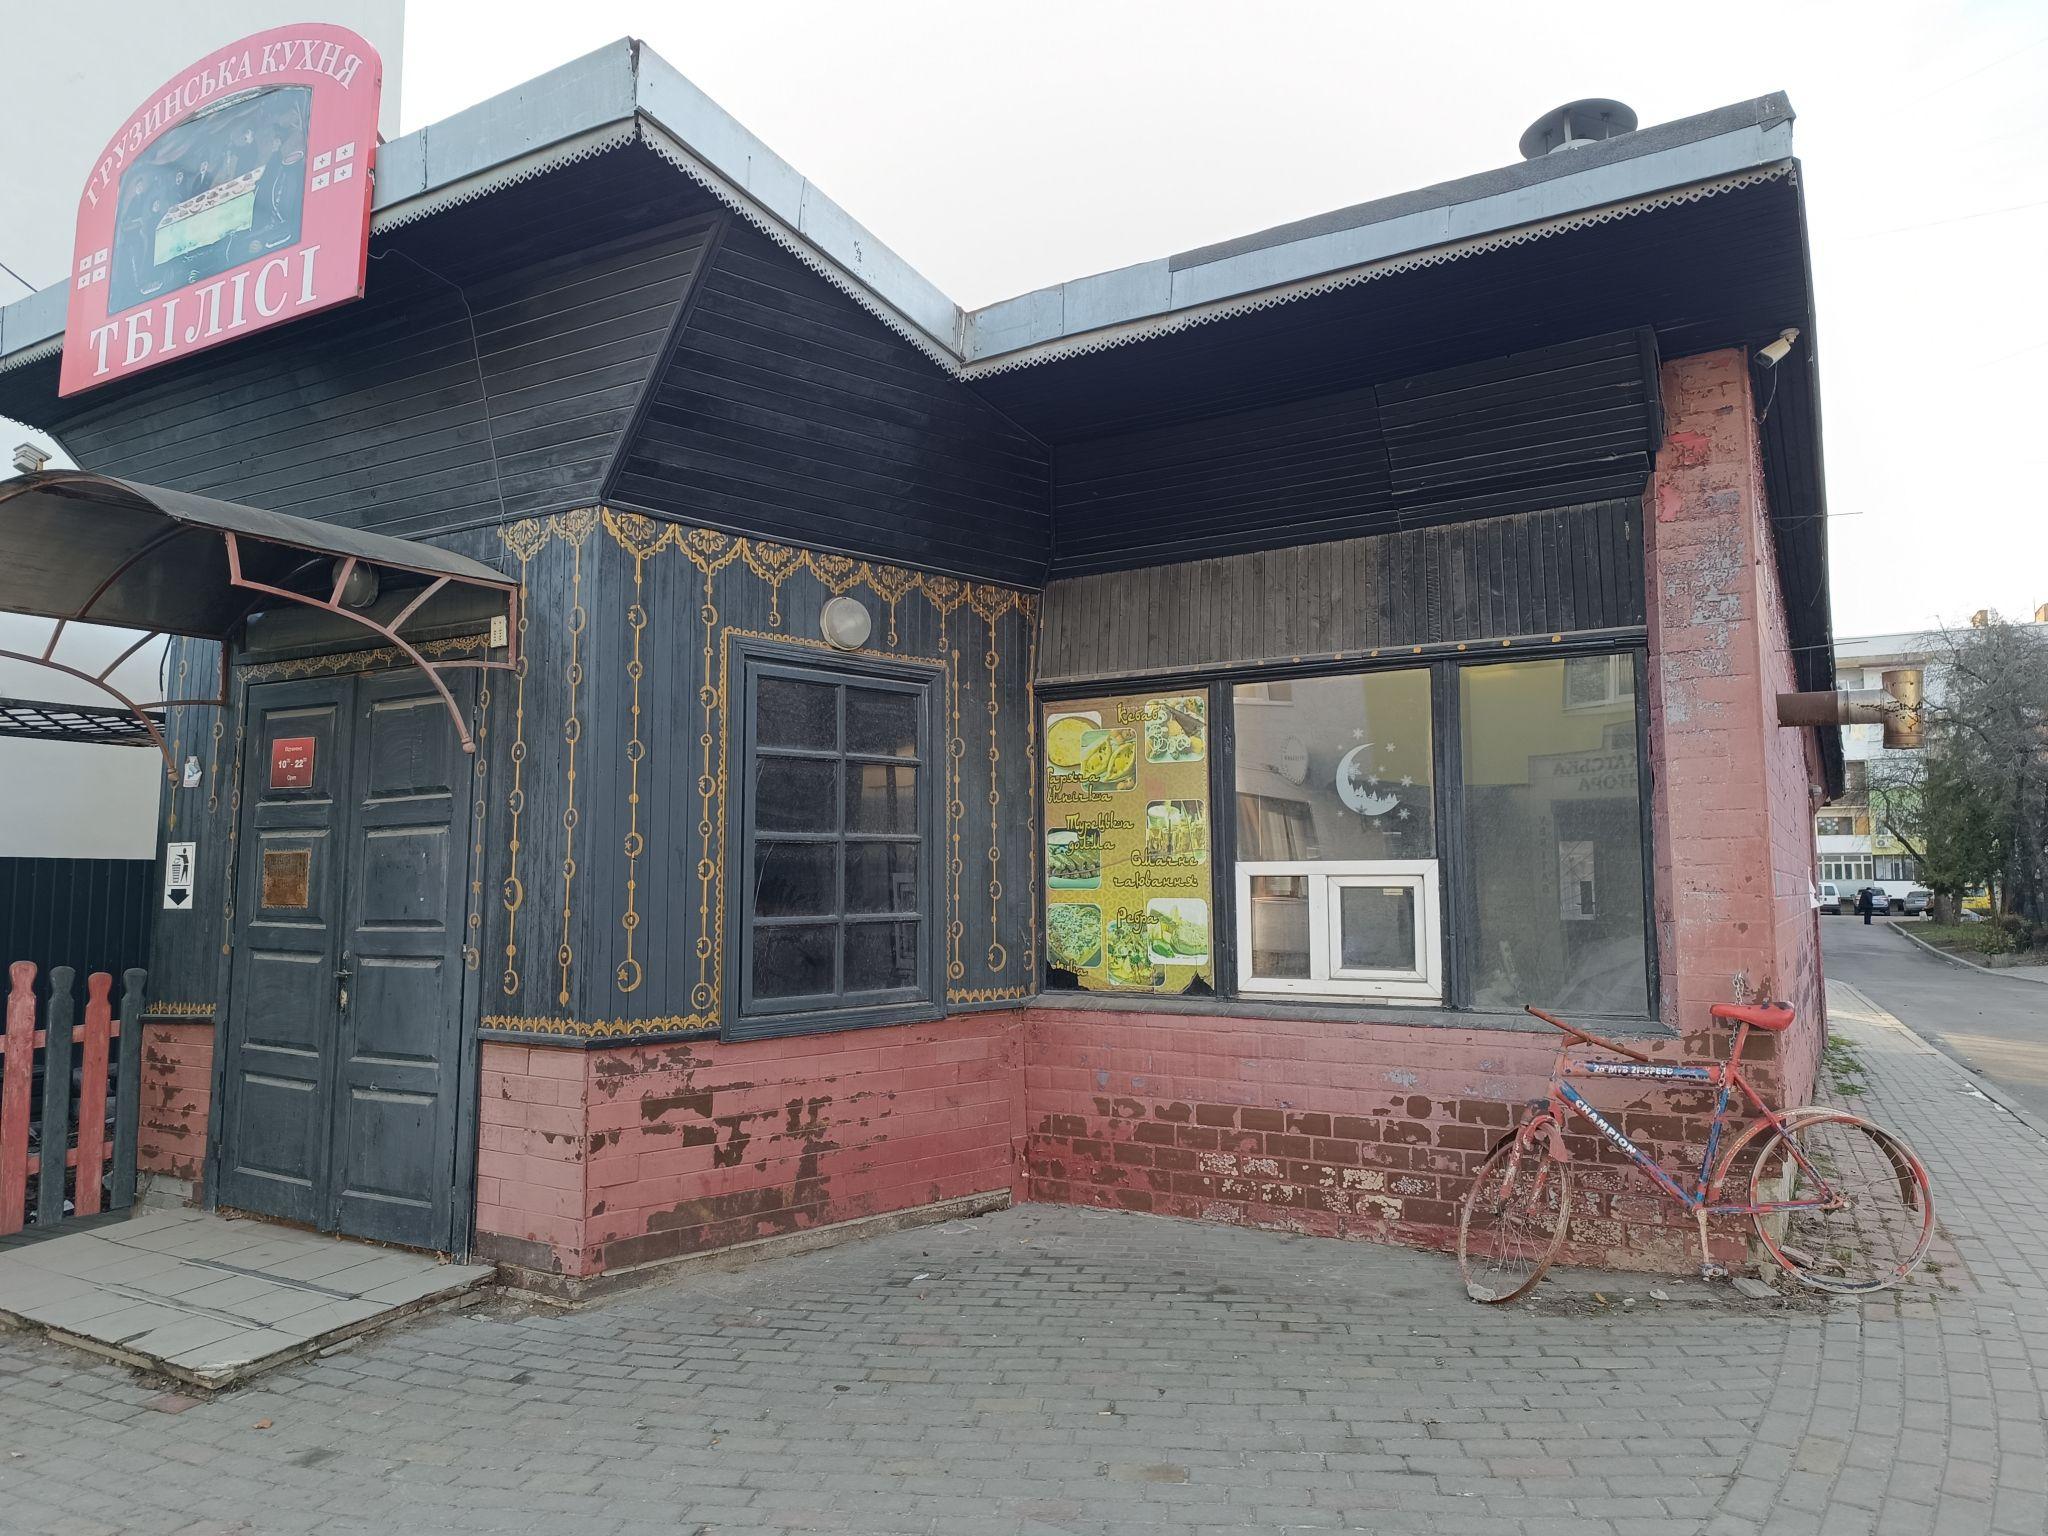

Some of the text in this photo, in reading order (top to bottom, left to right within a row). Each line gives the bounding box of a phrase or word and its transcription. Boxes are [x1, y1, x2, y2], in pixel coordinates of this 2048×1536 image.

[86, 39, 364, 210] ГРУЗИНСЬКА КУХНЯ
[89, 244, 322, 377] ТБІЛІСІ
[1116, 702, 1161, 725] Кебаб
[1065, 811, 1135, 838] Турецька
[1131, 848, 1199, 867] Смачне
[1113, 870, 1199, 888] чаювання
[1117, 906, 1160, 934] Ребра
[1575, 1099, 1637, 1155] CHAMPION
